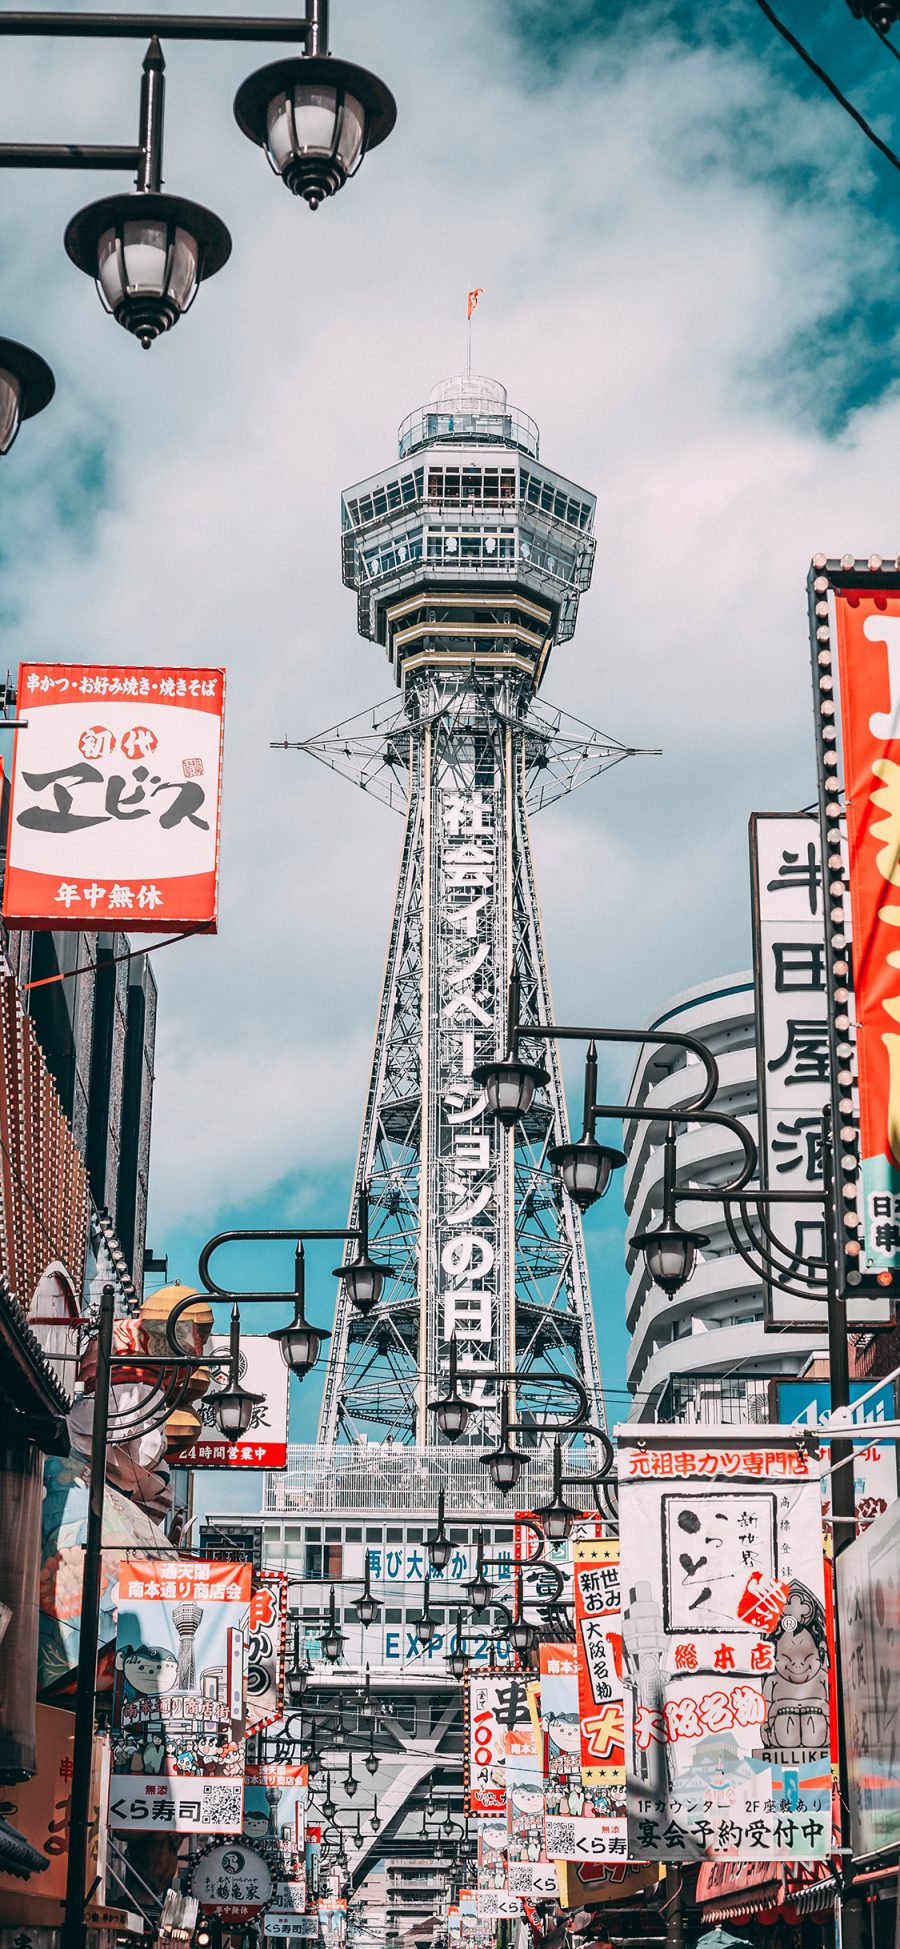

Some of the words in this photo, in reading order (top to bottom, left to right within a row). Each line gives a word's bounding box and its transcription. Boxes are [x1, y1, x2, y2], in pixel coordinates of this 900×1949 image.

[26, 672, 217, 696] 串かつ・お好み焼き・焼きそば
[81, 727, 157, 759] 初代
[54, 883, 163, 909] 年中無休
[198, 1402, 272, 1429] 鶴家
[629, 1451, 810, 1476] 元祖串カツ専門店
[780, 1495, 793, 1579] 商標登録
[160, 1563, 210, 1580] 通天閣
[128, 1581, 243, 1600] 南本通り商店会
[586, 1620, 613, 1700] 大阪名物
[674, 1642, 776, 1672] 総本店
[123, 1699, 231, 1722] 南本通り商店街
[633, 1685, 768, 1749] 大阪名物
[144, 1784, 168, 1795] 無添
[110, 1798, 201, 1822] くら寿司
[636, 1818, 825, 1850] 宴会予約受付中
